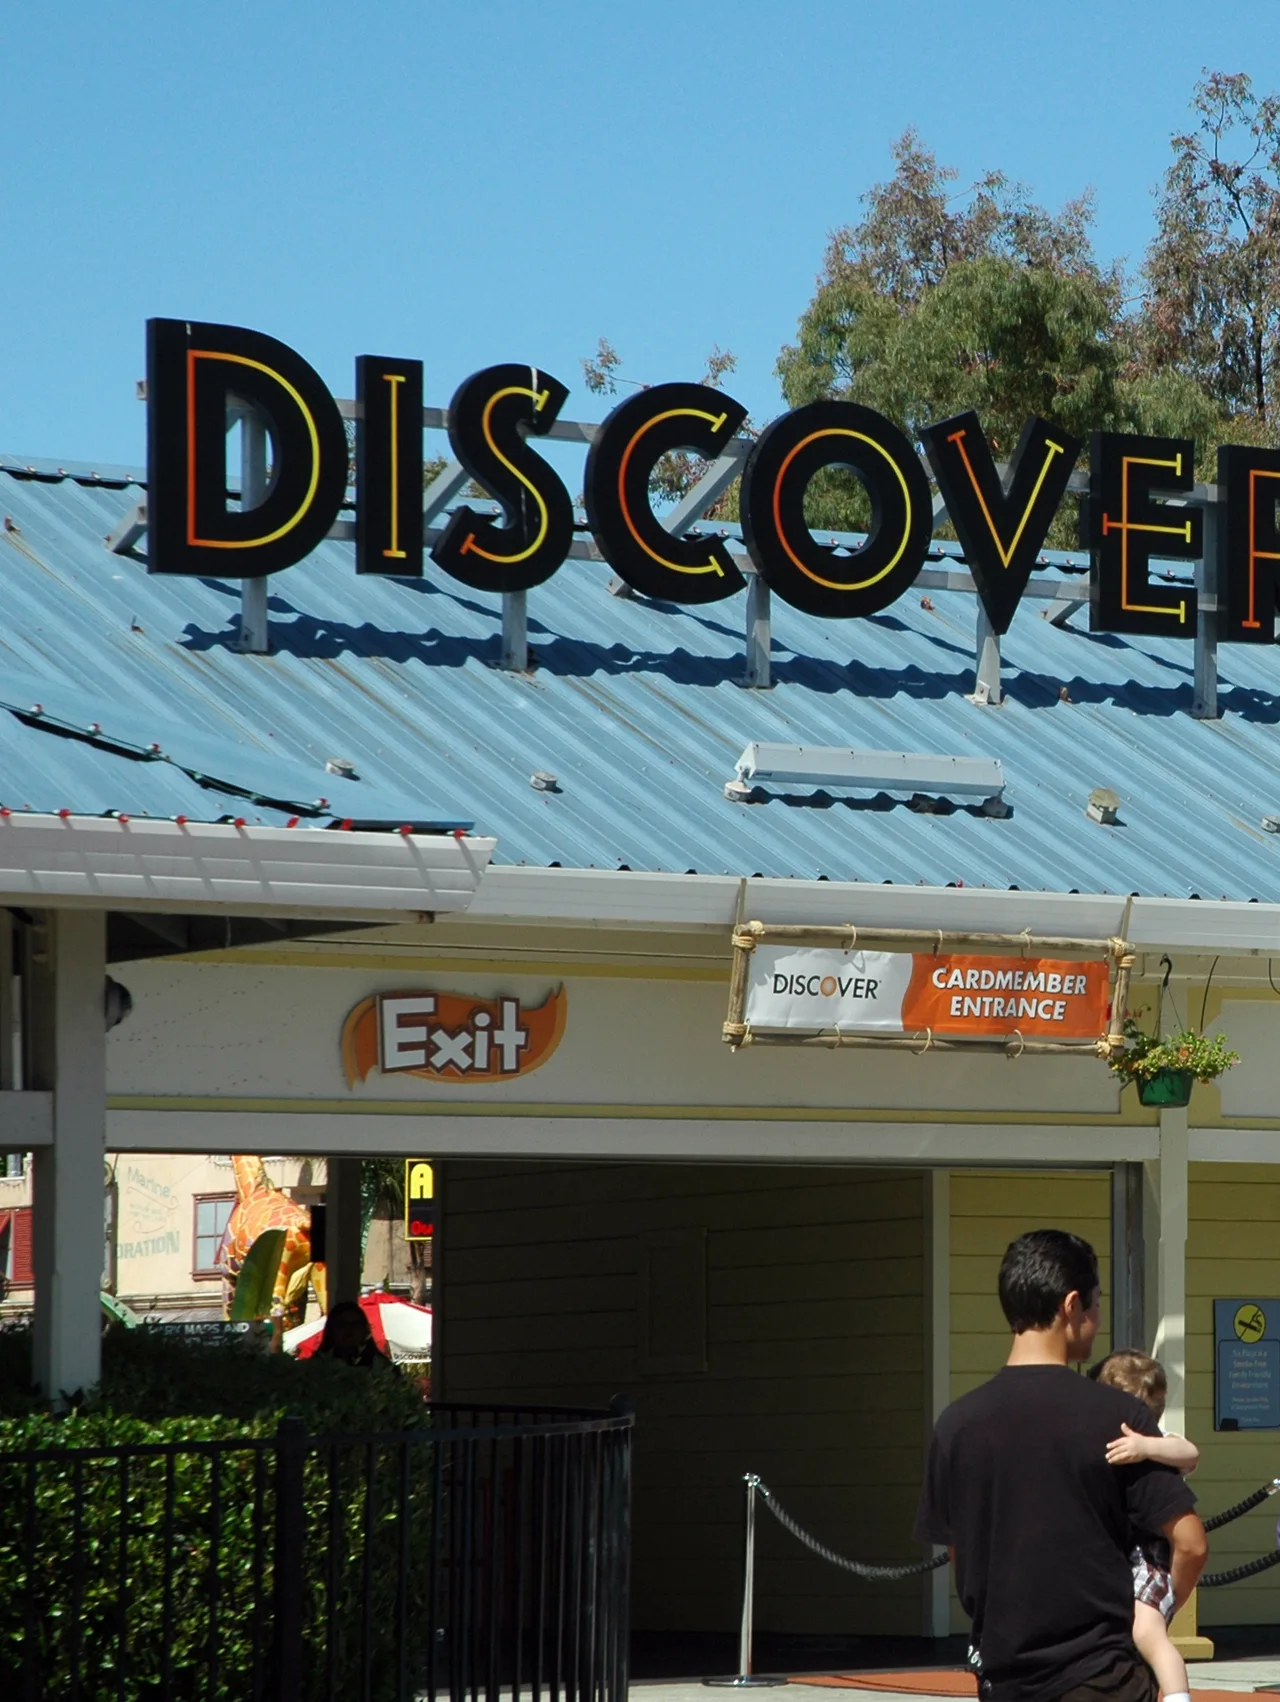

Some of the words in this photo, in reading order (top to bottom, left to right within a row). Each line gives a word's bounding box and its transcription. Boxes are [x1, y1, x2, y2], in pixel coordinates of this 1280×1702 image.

[773, 973, 880, 999] DISCOVER
[932, 967, 1088, 995] CARDMEMBER
[950, 996, 1067, 1021] ENTRANCE
[380, 995, 529, 1073] Exit
